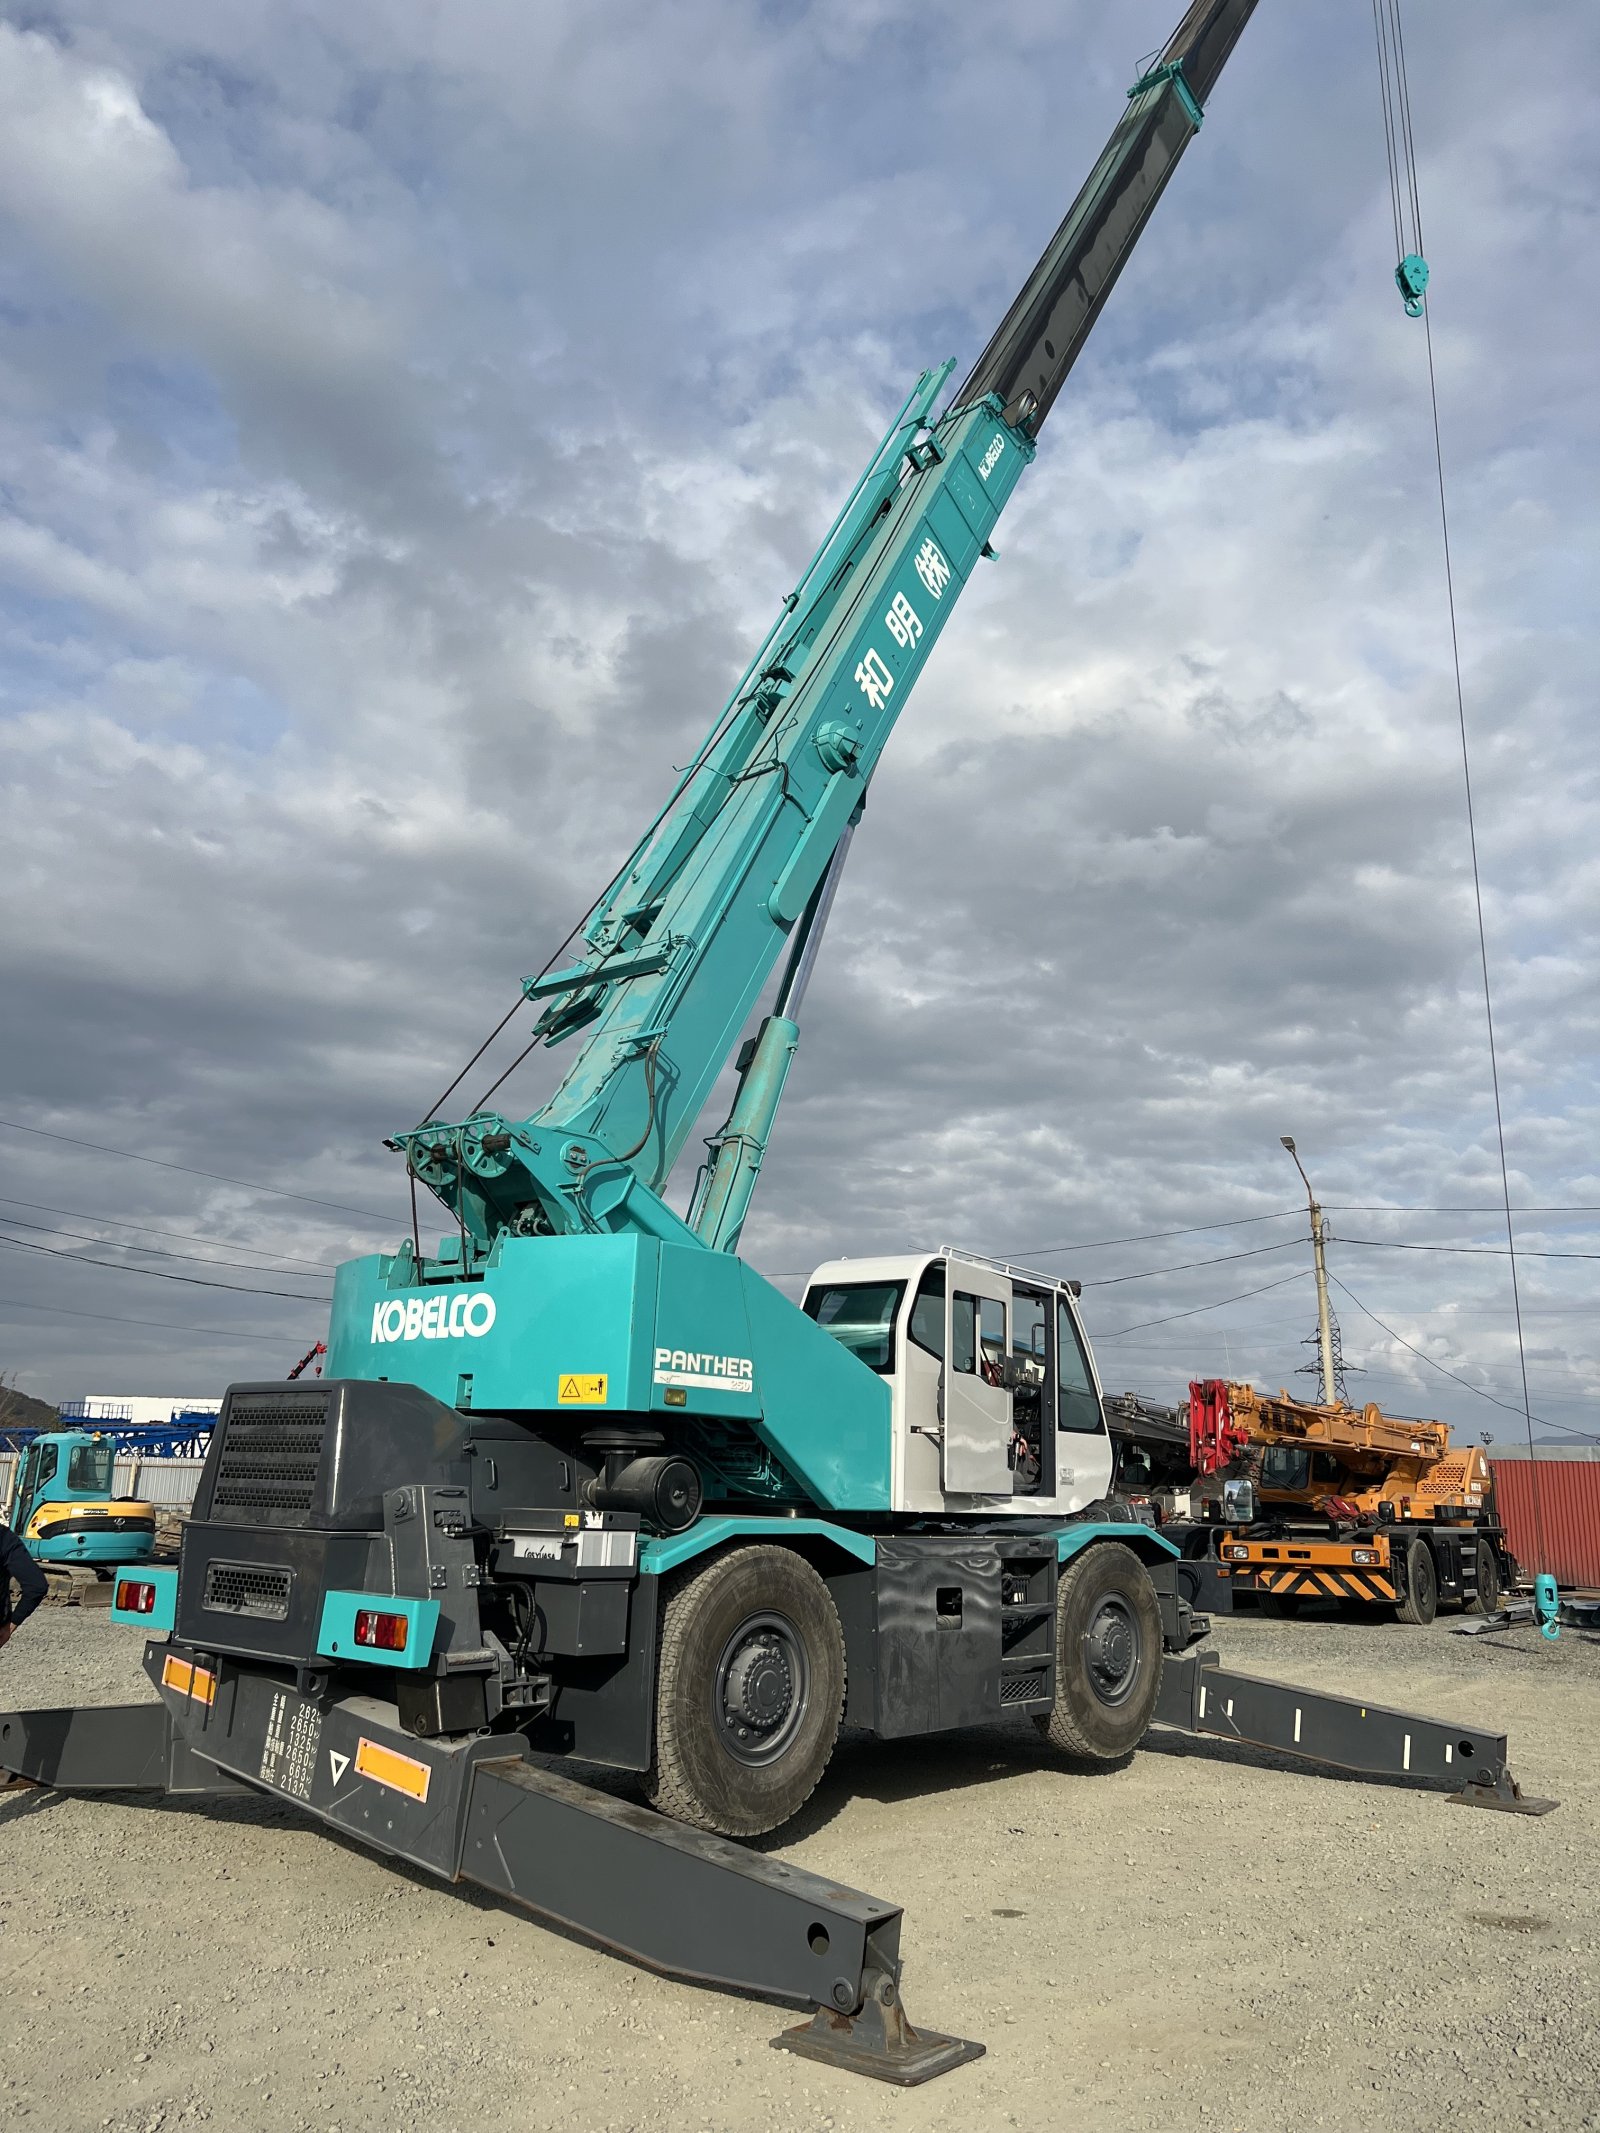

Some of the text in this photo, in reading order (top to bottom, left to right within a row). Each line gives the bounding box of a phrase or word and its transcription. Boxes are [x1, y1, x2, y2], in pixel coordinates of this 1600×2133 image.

[370, 1292, 497, 1344] KOBELCO
[654, 1347, 753, 1378] PANTHER
[299, 1702, 317, 1722] 2.62
[290, 1715, 315, 1737] 26.50
[290, 1731, 311, 1752] 13.25
[286, 1745, 309, 1767] 26.50
[289, 1762, 306, 1782] 6.63
[280, 1774, 304, 1797] 213.7
